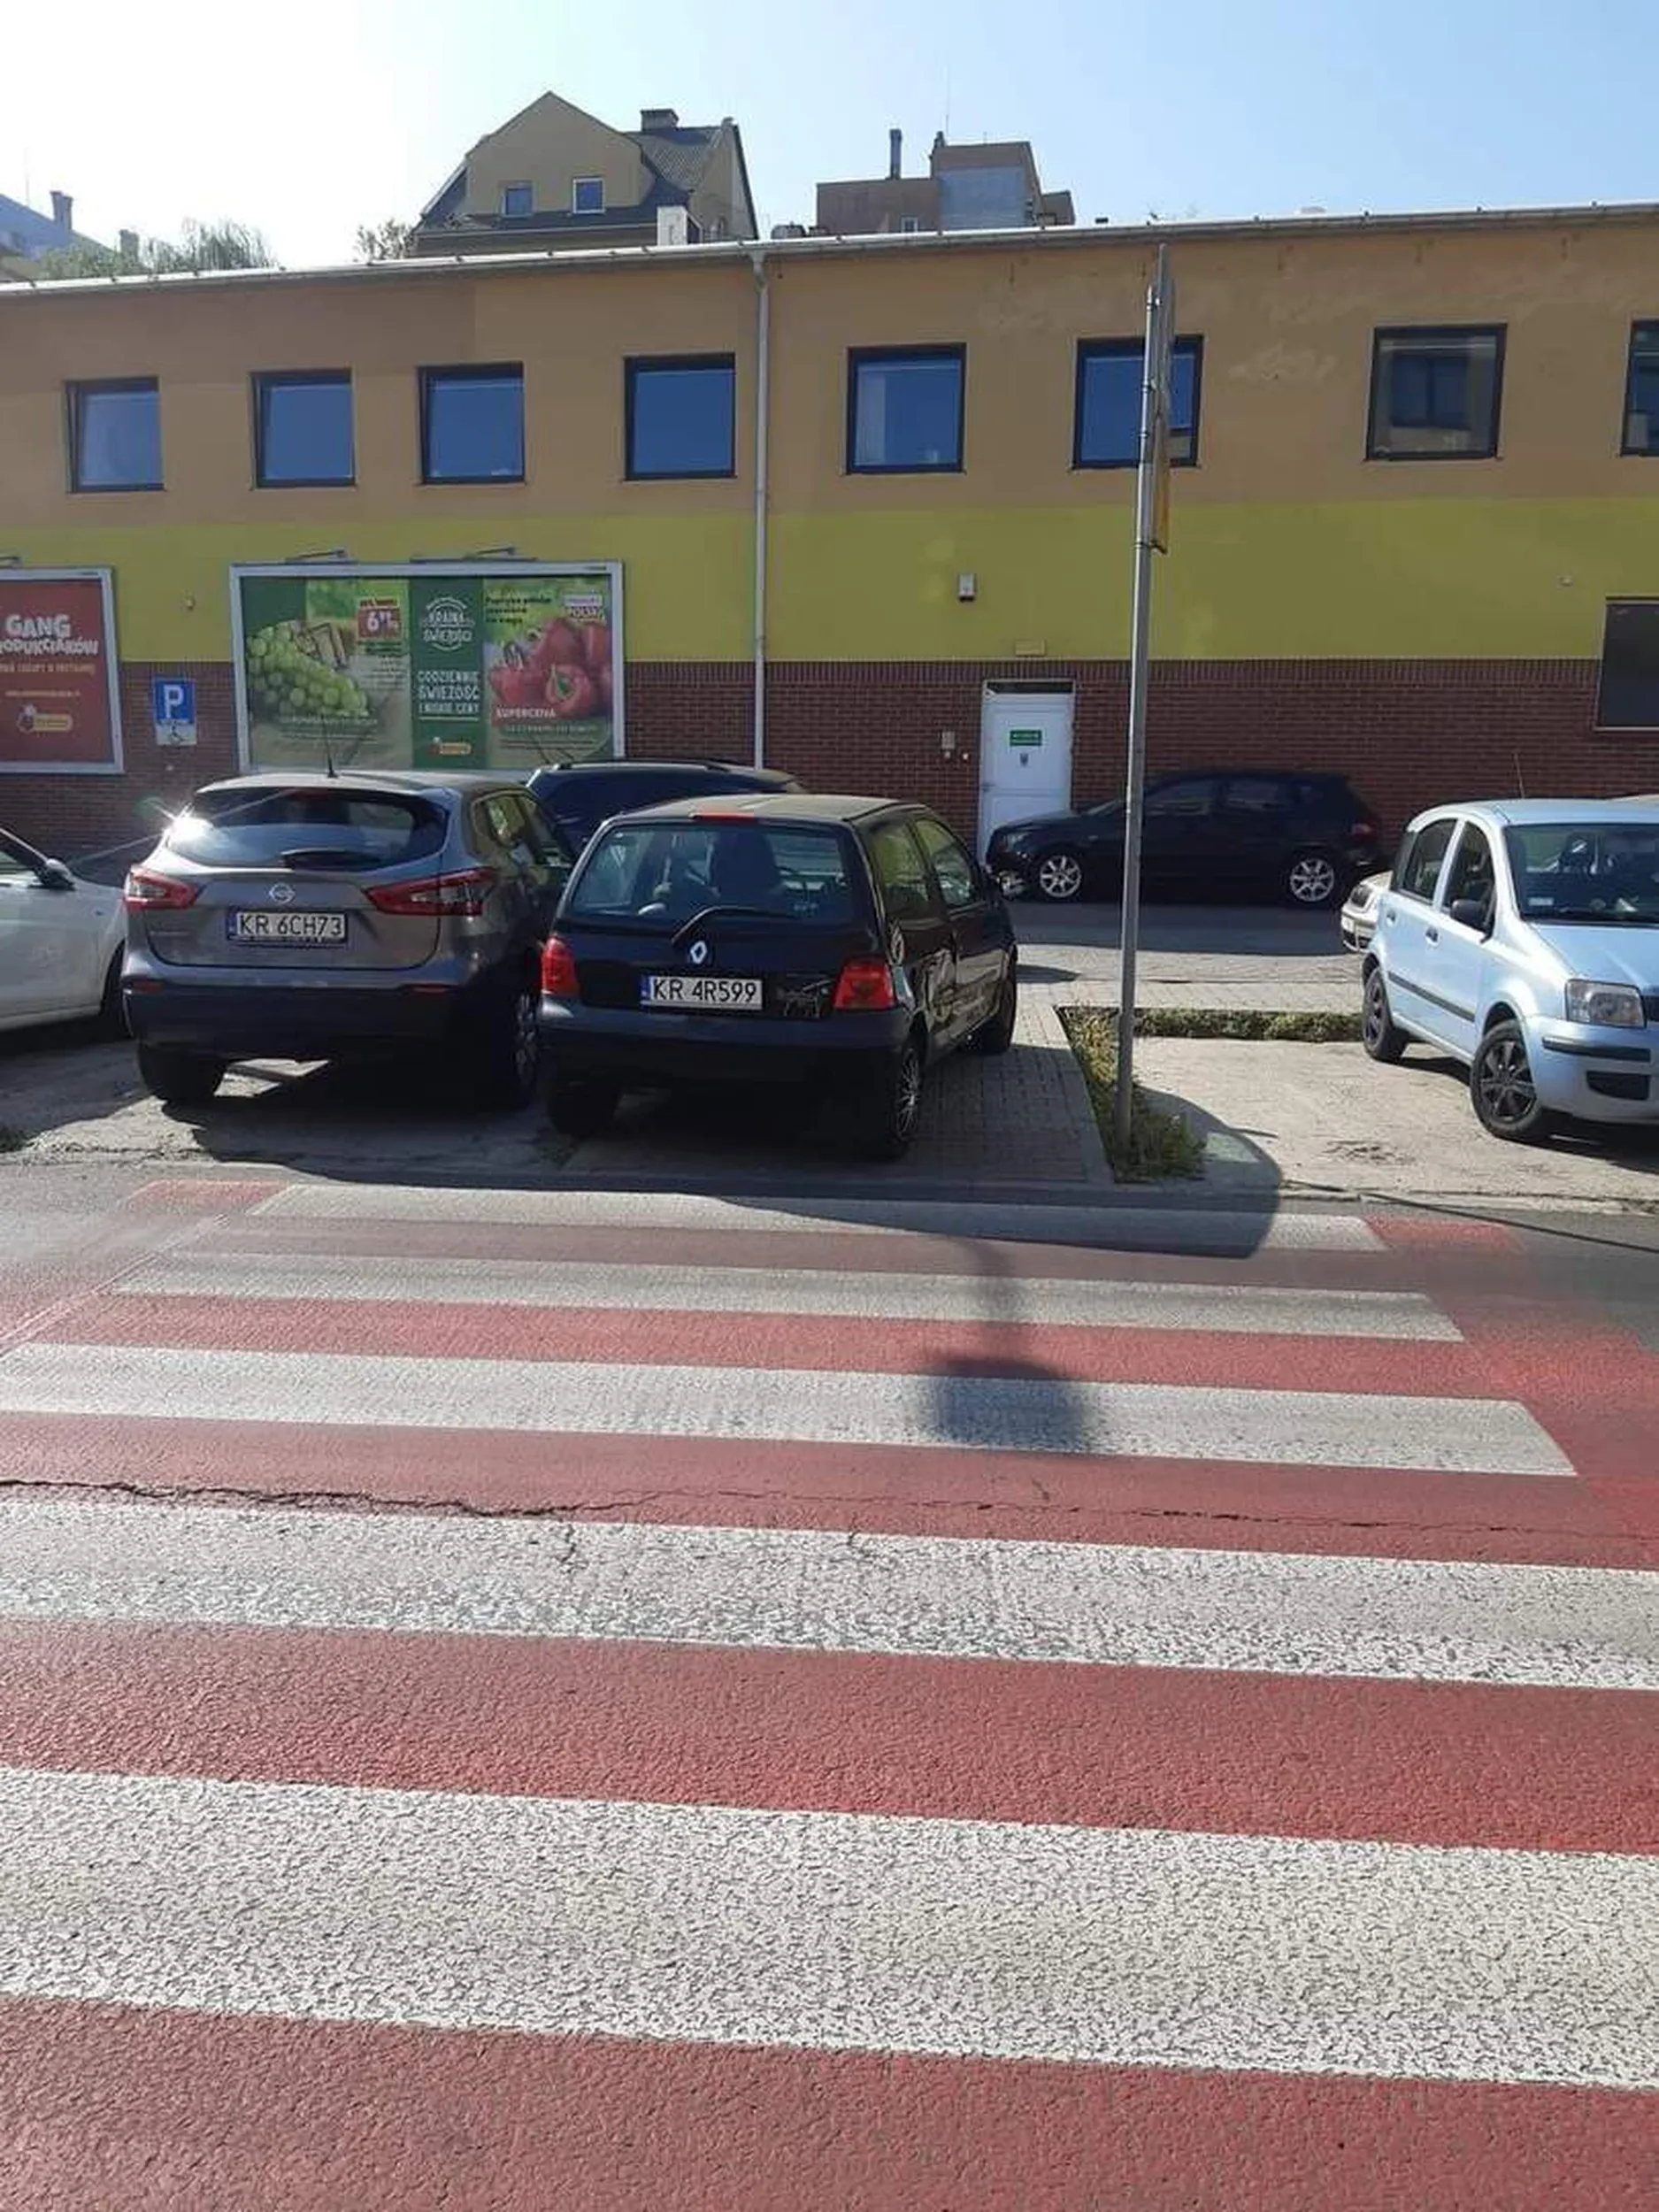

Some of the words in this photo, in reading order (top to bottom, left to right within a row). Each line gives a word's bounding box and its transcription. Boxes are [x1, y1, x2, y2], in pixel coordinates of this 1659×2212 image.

[6, 614, 70, 638] GANG
[164, 684, 184, 718] P
[240, 915, 269, 935] KR
[278, 915, 342, 936] 6CH73
[653, 979, 683, 1000] KR
[692, 980, 757, 1002] 4R599
